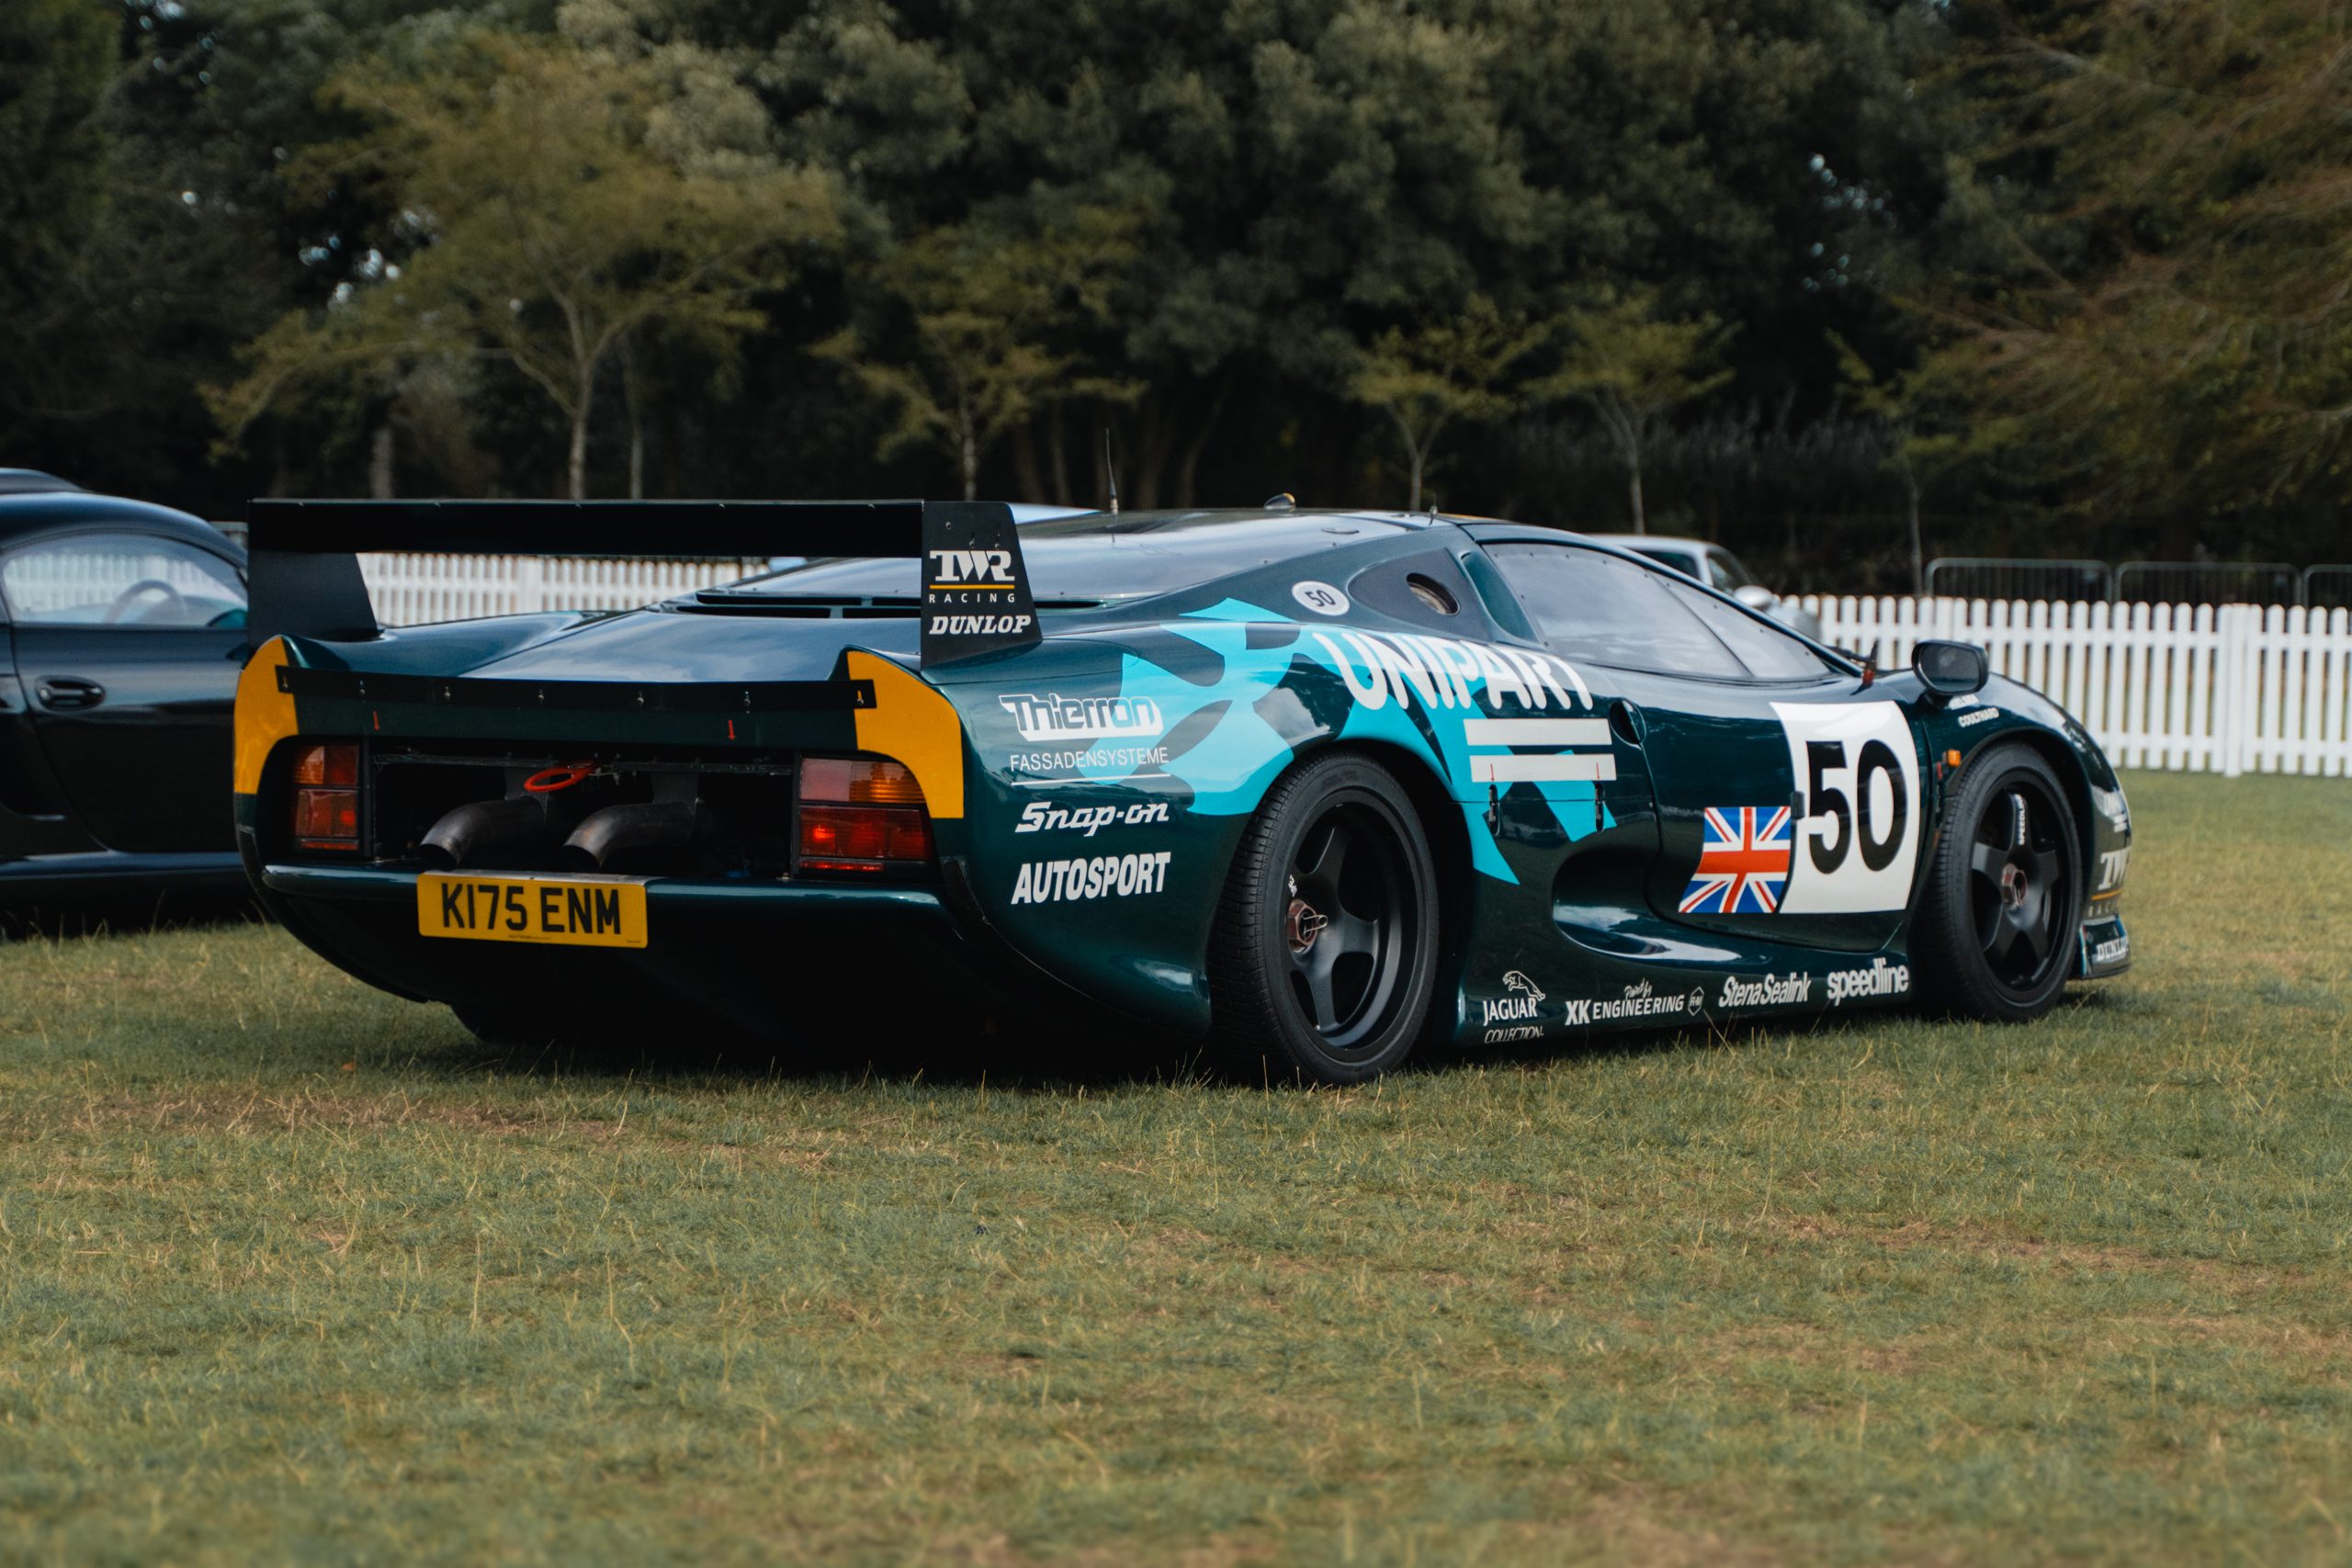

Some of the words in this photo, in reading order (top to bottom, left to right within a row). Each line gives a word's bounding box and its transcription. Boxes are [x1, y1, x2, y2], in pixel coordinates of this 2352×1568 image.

[929, 550, 1015, 581] TWR
[929, 592, 1015, 604] RACING
[1304, 590, 1336, 607] 50
[929, 615, 1031, 635] DUNLOP
[1312, 631, 1594, 710] UNIPART
[1011, 747, 1170, 772] FASSADENSYSTEME
[1014, 801, 1170, 837] Snap-on
[1806, 739, 1908, 874] 50
[1011, 852, 1171, 905] AUTOSPORT
[441, 883, 527, 931] K175
[540, 886, 621, 935] ENM
[1827, 957, 1909, 1007] speedline
[1483, 998, 1538, 1027] JAGUAR
[1565, 999, 1592, 1026] XK
[1592, 994, 1685, 1020] ENGINEERING
[1485, 1026, 1544, 1043] COLLECTION
